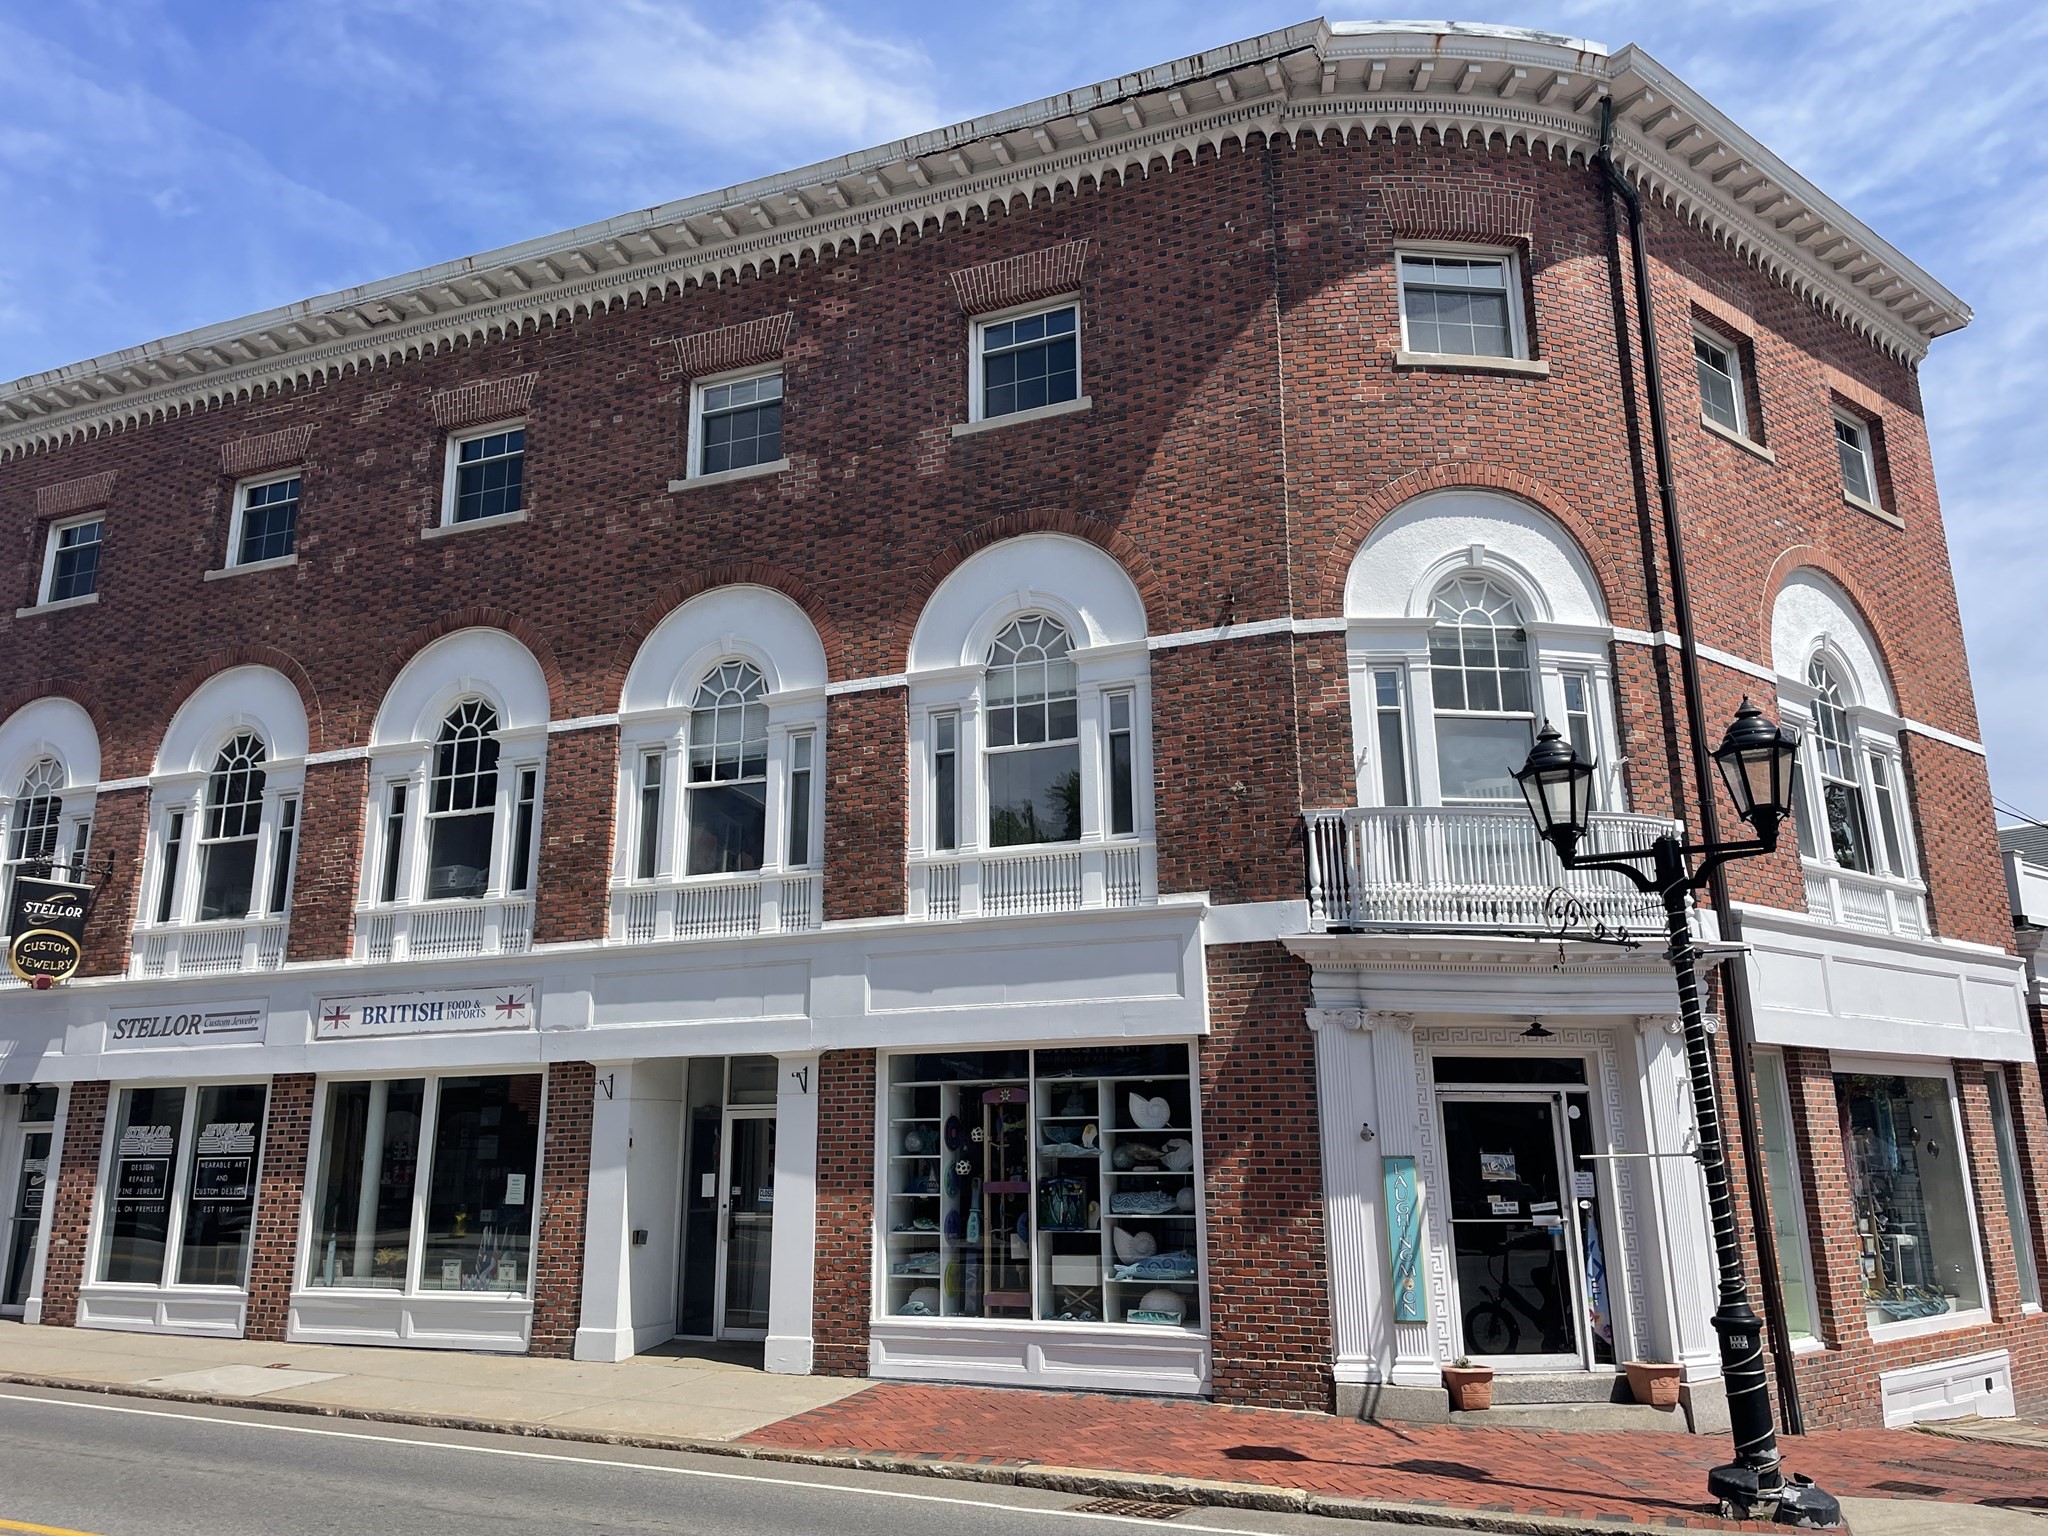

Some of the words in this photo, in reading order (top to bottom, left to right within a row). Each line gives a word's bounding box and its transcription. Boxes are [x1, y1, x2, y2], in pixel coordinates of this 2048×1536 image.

[23, 901, 83, 918] STELLOR
[23, 941, 70, 955] CUSTOM
[17, 955, 73, 970] JEWELRY
[446, 1000, 471, 1010] FOOD
[474, 999, 481, 1009] &
[360, 1001, 445, 1025] BRITISH
[446, 1008, 486, 1020] IMPORTS
[112, 1014, 203, 1040] STELLOR
[203, 1017, 230, 1028] Custom
[230, 1015, 259, 1027] Jewelry
[124, 1125, 172, 1138] STELLOR
[202, 1122, 255, 1137] JEWELRY
[215, 1174, 228, 1182] AND
[136, 1187, 161, 1195] JEWELRY
[759, 1188, 774, 1198] CLOSE
[110, 1205, 121, 1213] ALL
[124, 1205, 133, 1213] ON
[135, 1205, 165, 1213] PREMISES
[203, 1205, 215, 1213] EST
[218, 1205, 233, 1213] 1991
[1392, 1161, 1415, 1263] LAUGHING
